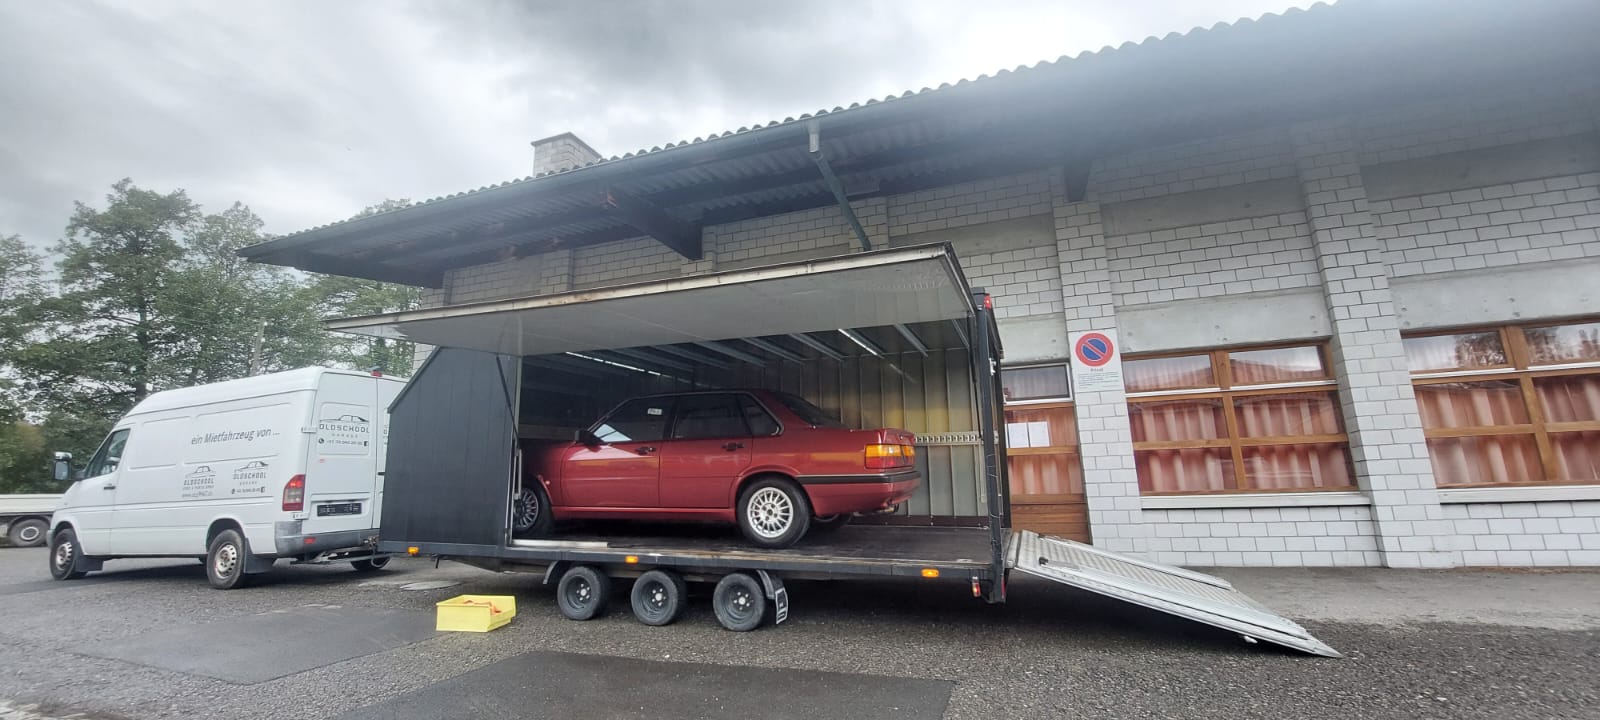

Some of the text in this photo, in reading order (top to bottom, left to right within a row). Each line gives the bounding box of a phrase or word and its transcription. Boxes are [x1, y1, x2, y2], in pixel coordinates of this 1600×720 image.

[319, 423, 370, 433] OLDSCHOOL
[191, 435, 203, 445] ein
[204, 429, 255, 443] Mietfahrzeug
[256, 428, 272, 438] von
